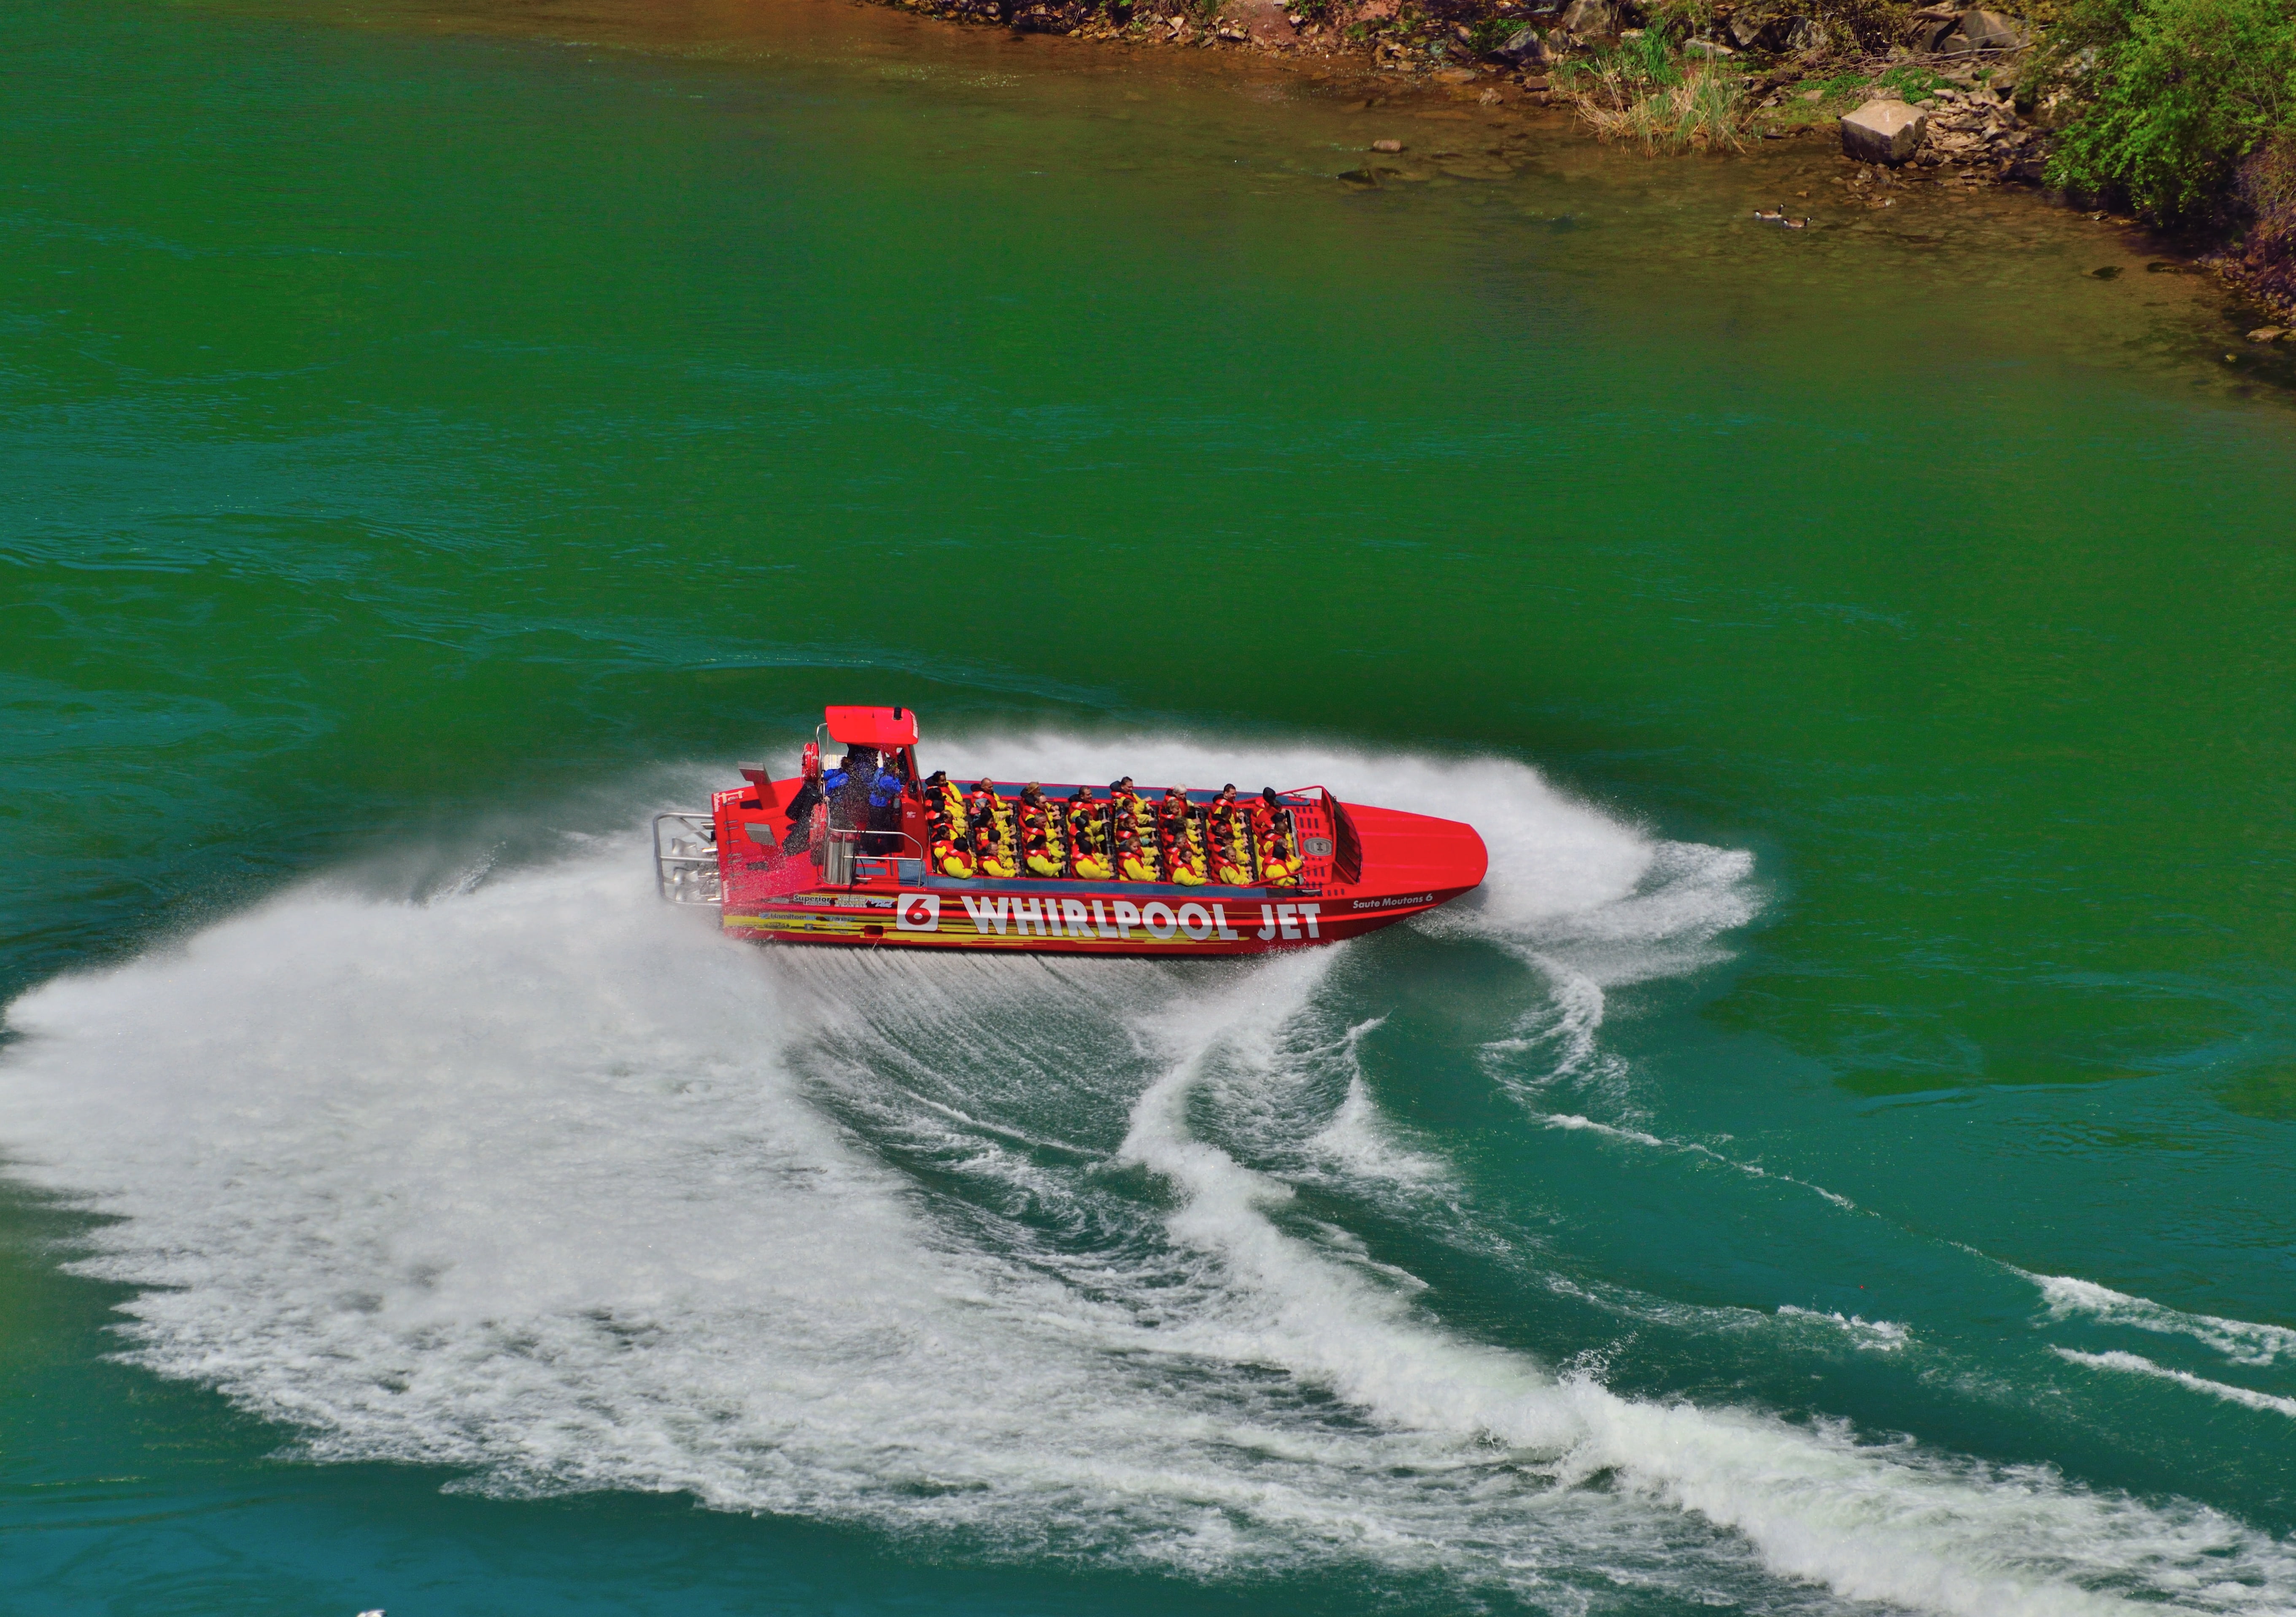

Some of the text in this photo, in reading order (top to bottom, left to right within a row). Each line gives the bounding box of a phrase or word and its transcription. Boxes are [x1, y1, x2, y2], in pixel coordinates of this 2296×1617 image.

[794, 895, 831, 905] Superior
[1353, 893, 1433, 908] Saute Moutons 6
[905, 898, 931, 925] 6
[960, 896, 1321, 941] WHIRLPOOL JET
